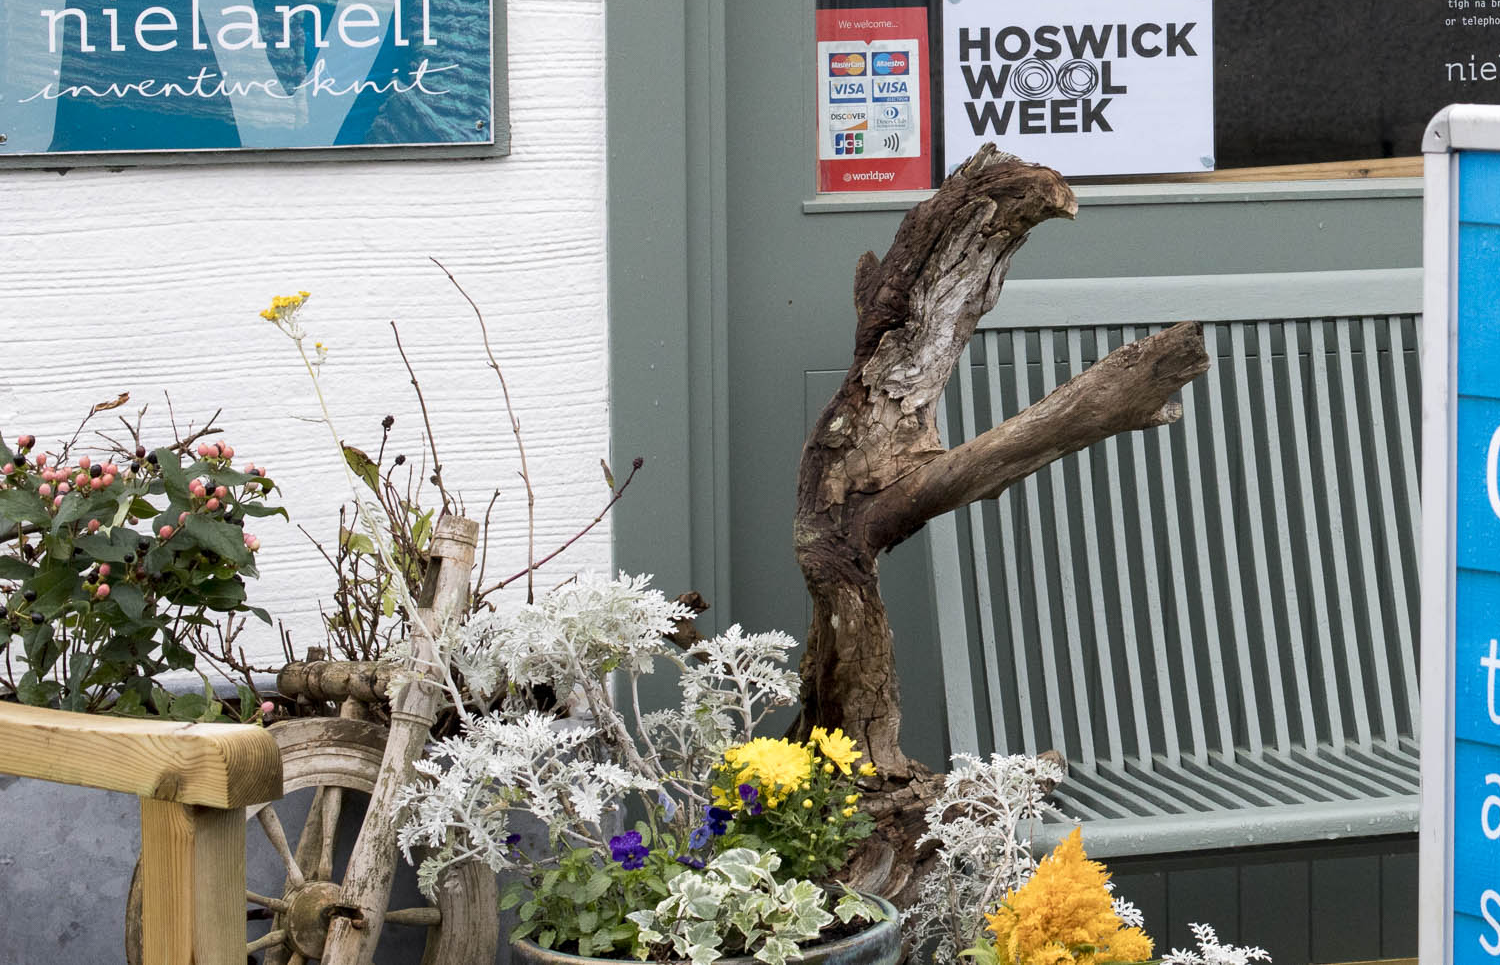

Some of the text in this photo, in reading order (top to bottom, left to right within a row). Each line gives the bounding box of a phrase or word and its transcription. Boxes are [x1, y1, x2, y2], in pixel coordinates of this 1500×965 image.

[1448, 0, 1470, 9] tigh
[1474, 0, 1486, 8] na
[838, 20, 852, 29] We
[1445, 18, 1456, 26] or
[959, 22, 1198, 63] HOSWICK
[876, 60, 905, 68] Maestro
[18, 60, 459, 103] inventive knit
[960, 57, 1128, 101] WOOL
[833, 83, 865, 95] VISA
[877, 81, 908, 94] VISA
[831, 112, 866, 121] DISCOVER
[964, 97, 1114, 136] WEEK
[834, 139, 864, 148] JCB
[852, 171, 895, 182] worldpay
